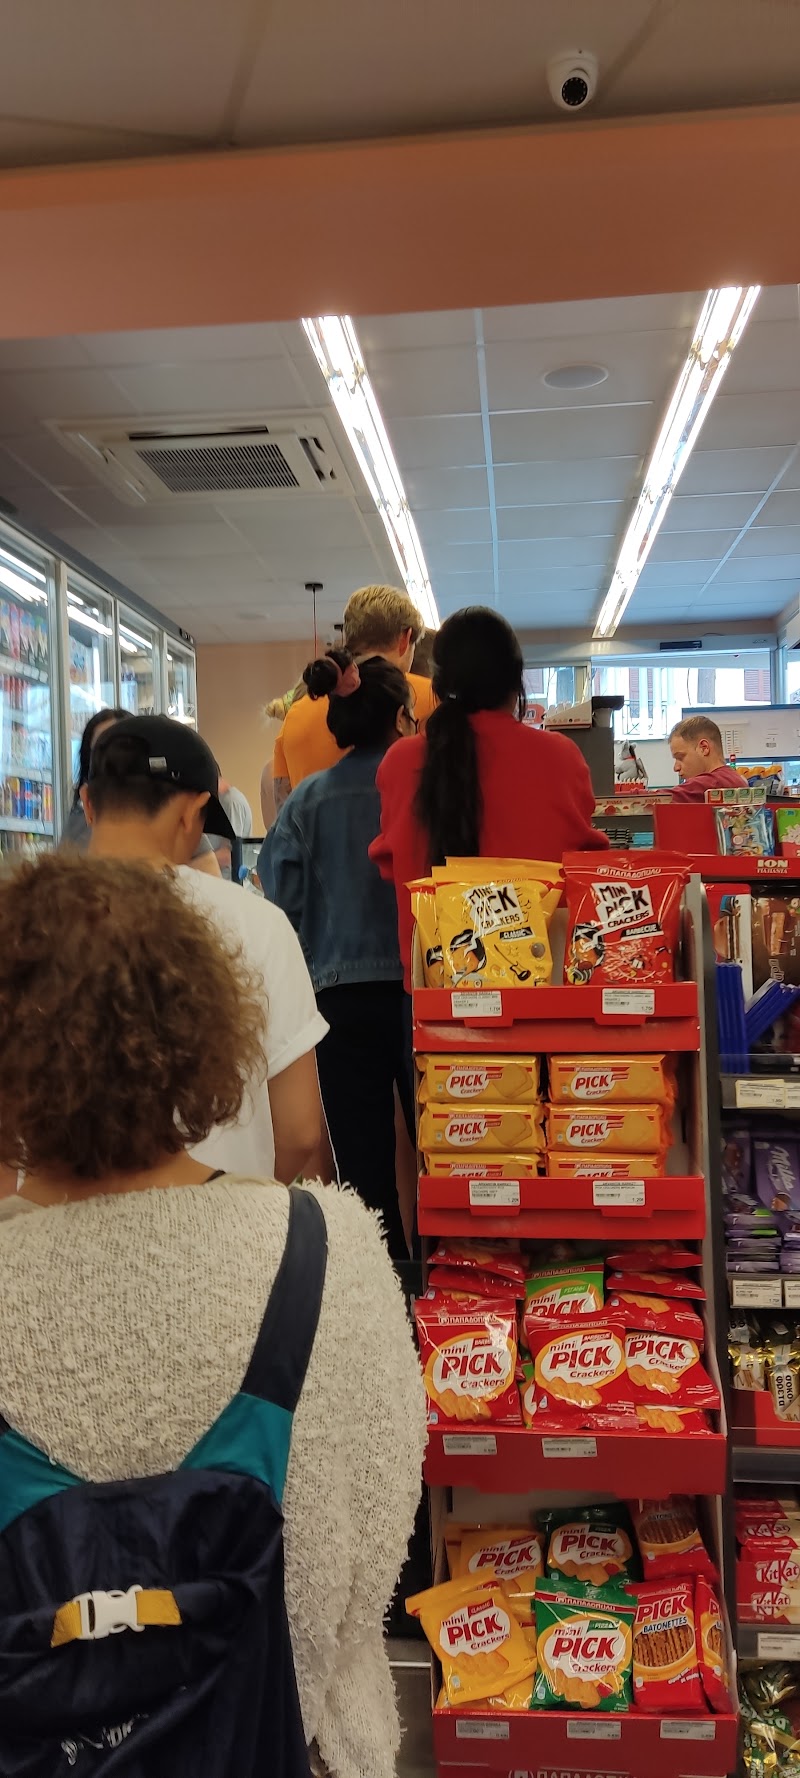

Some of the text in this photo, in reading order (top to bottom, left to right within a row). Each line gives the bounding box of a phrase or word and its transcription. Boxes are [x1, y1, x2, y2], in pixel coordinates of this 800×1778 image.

[599, 885, 628, 902] MINI
[605, 890, 649, 919] PICK
[481, 914, 520, 929] CRAKERS
[608, 910, 650, 928] CRACKERS
[450, 1074, 484, 1088] PICK
[575, 1074, 609, 1090] PICK
[448, 1122, 482, 1137] PICK
[570, 1123, 605, 1138] PICK
[768, 1146, 796, 1192] Milka
[530, 1294, 554, 1306] mini
[441, 1346, 467, 1355] mini
[550, 1341, 576, 1352] mini
[628, 1340, 686, 1361] PICK
[550, 1345, 613, 1370] PICK
[440, 1352, 503, 1380] PICK
[570, 1368, 615, 1378] Crackers
[560, 1527, 584, 1536] mini
[560, 1534, 616, 1552] PICK
[476, 1546, 534, 1568] PICK
[494, 1565, 535, 1574] Crackers
[756, 1560, 800, 1585] KitKat
[636, 1594, 688, 1624] PICK
[753, 1592, 790, 1616] KitKat
[442, 1614, 464, 1627] mini
[643, 1616, 688, 1632] BATONETTES
[446, 1614, 502, 1646] PICK
[554, 1627, 581, 1636] mini
[470, 1634, 510, 1650] Crackers
[552, 1637, 618, 1660] PICK
[572, 1662, 616, 1673] Crackers
